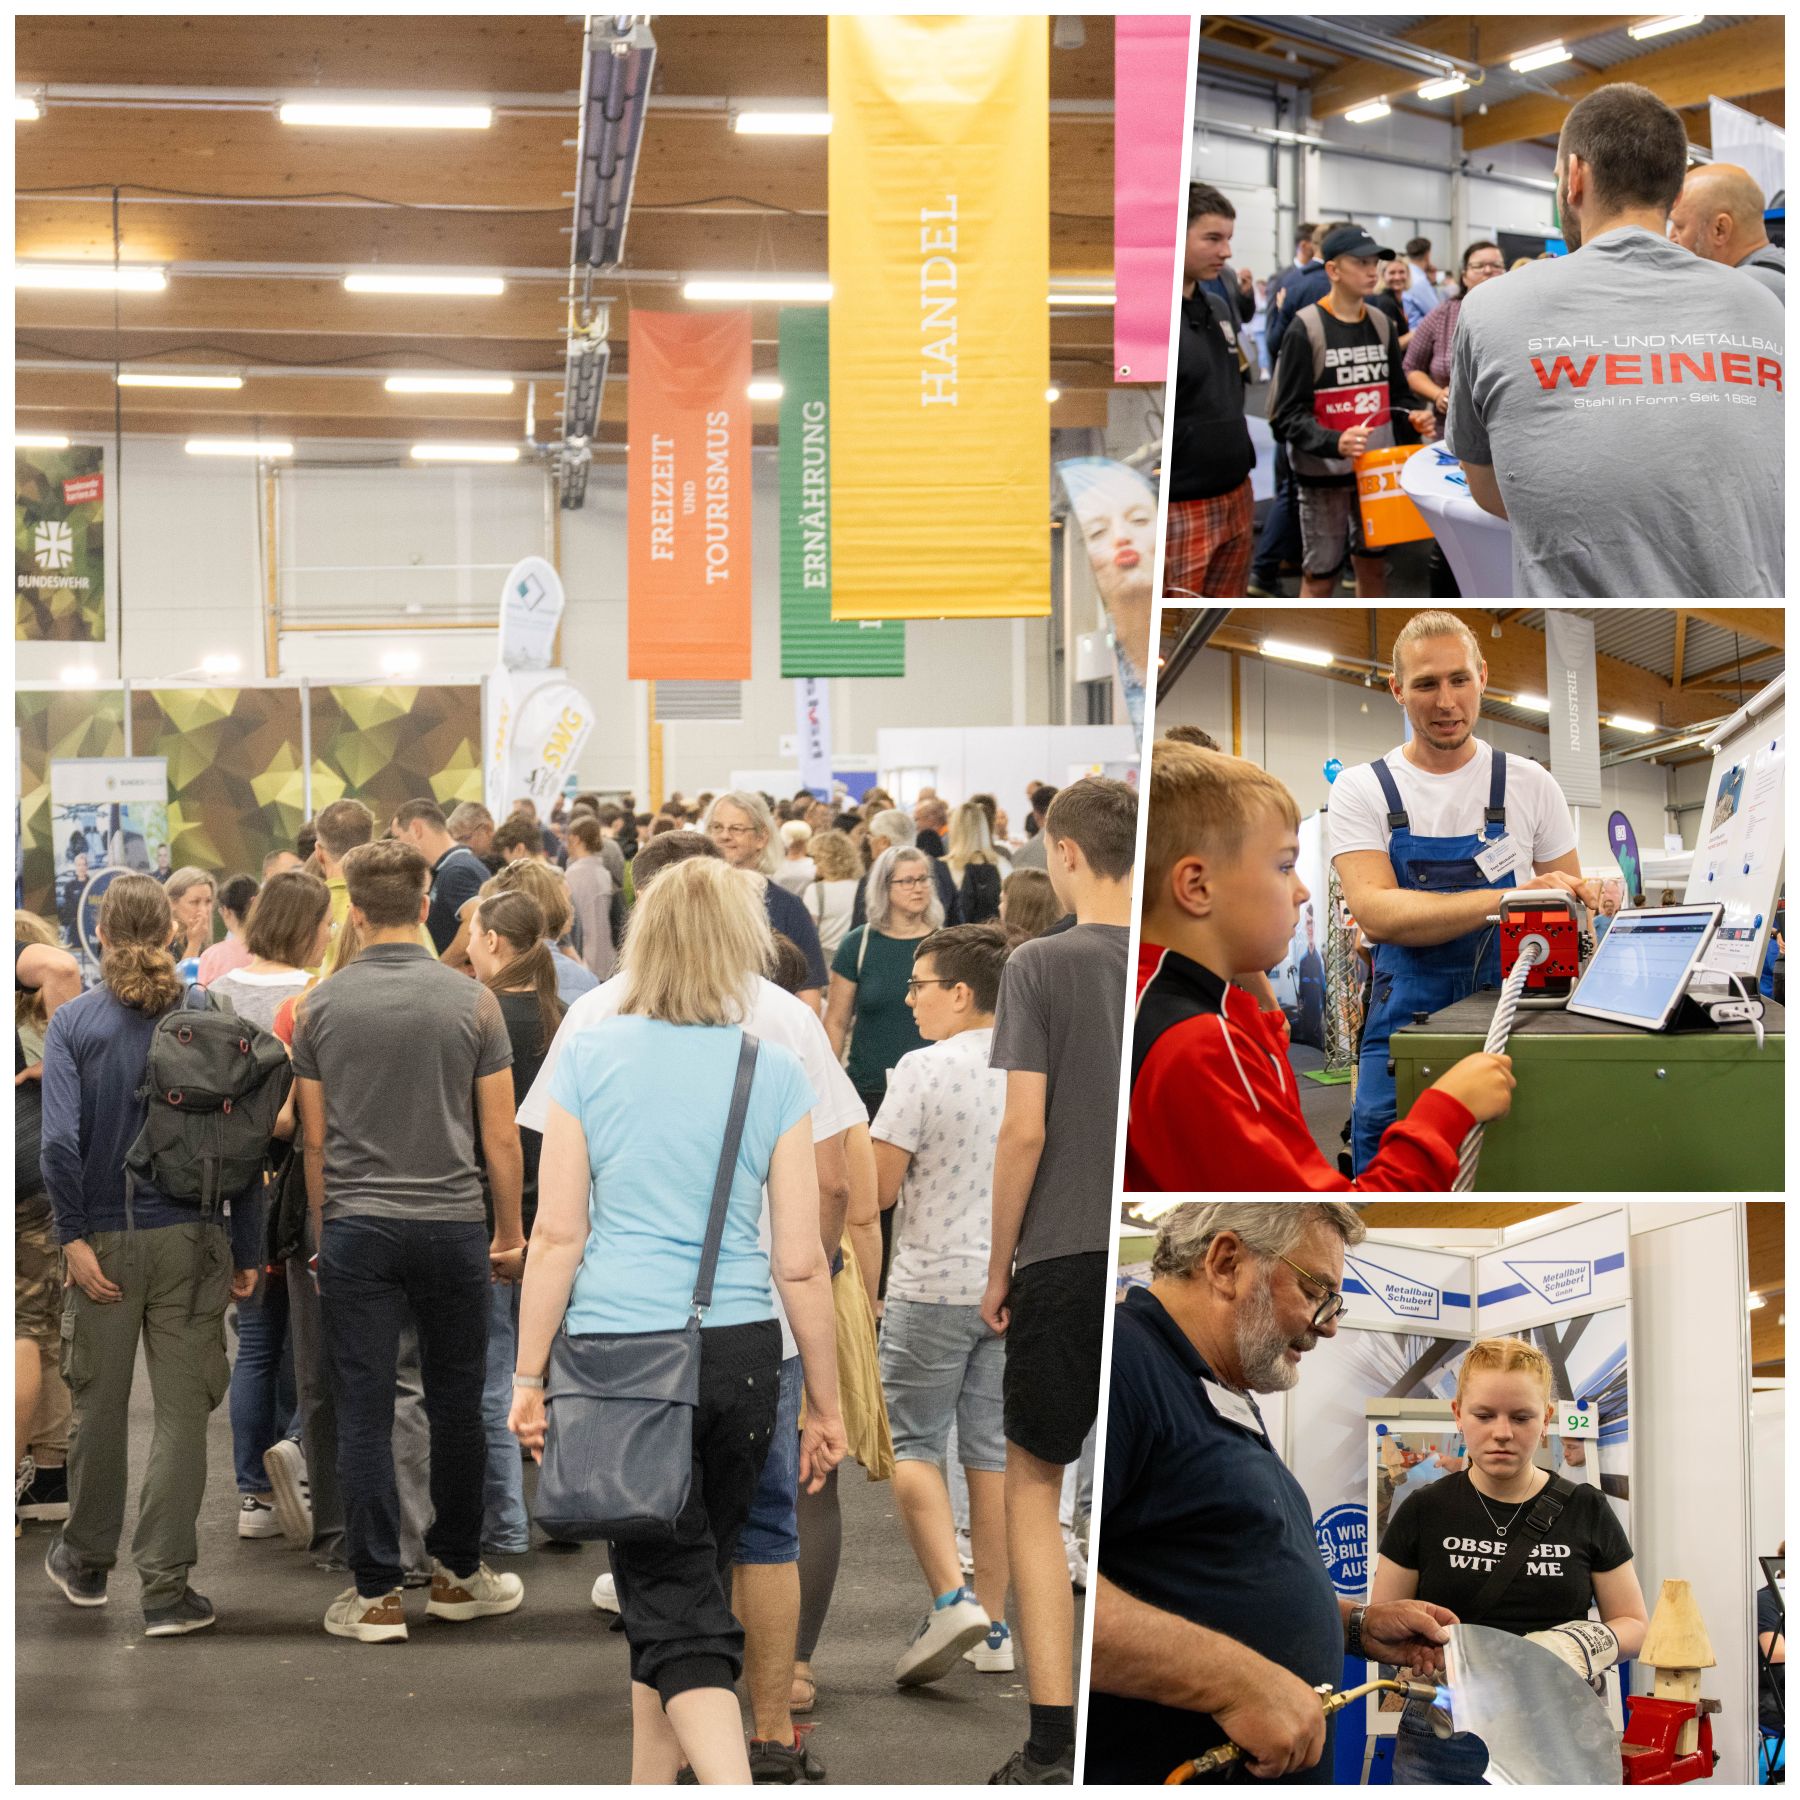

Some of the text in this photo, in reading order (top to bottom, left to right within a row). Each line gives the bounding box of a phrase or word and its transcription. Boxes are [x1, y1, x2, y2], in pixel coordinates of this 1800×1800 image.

[920, 194, 959, 407] HANDEL
[1528, 333, 1783, 356] STAHL- UND METALLBAU
[1529, 351, 1783, 393] WEINER
[1354, 390, 1380, 415] 23
[1574, 398, 1614, 409] Stahl
[1618, 397, 1631, 406] in
[1635, 395, 1678, 406] Form
[1689, 392, 1720, 403] Seit
[1724, 393, 1757, 406] 1892
[651, 433, 674, 561] FREIZEIT
[682, 480, 696, 515] UND
[705, 410, 730, 585] TOURISMUS
[800, 400, 827, 589] ERNÄHRUNG
[17, 575, 90, 588] BUNDESWEHR
[1567, 670, 1581, 752] INDUSTRIE
[543, 706, 583, 769] SWG
[1542, 1265, 1586, 1284] Metallbau
[1544, 1274, 1585, 1292] Schubert
[1385, 1284, 1434, 1298] Metallbau
[1387, 1293, 1432, 1306] Schubert
[1555, 1288, 1573, 1297] GmbH
[1400, 1304, 1420, 1312] GmbH
[1567, 1415, 1590, 1431] 92
[1336, 1524, 1367, 1541] WIR
[1442, 1536, 1571, 1558] OBSESED
[1341, 1560, 1368, 1579] AUS
[1449, 1554, 1564, 1577] WIT ME
